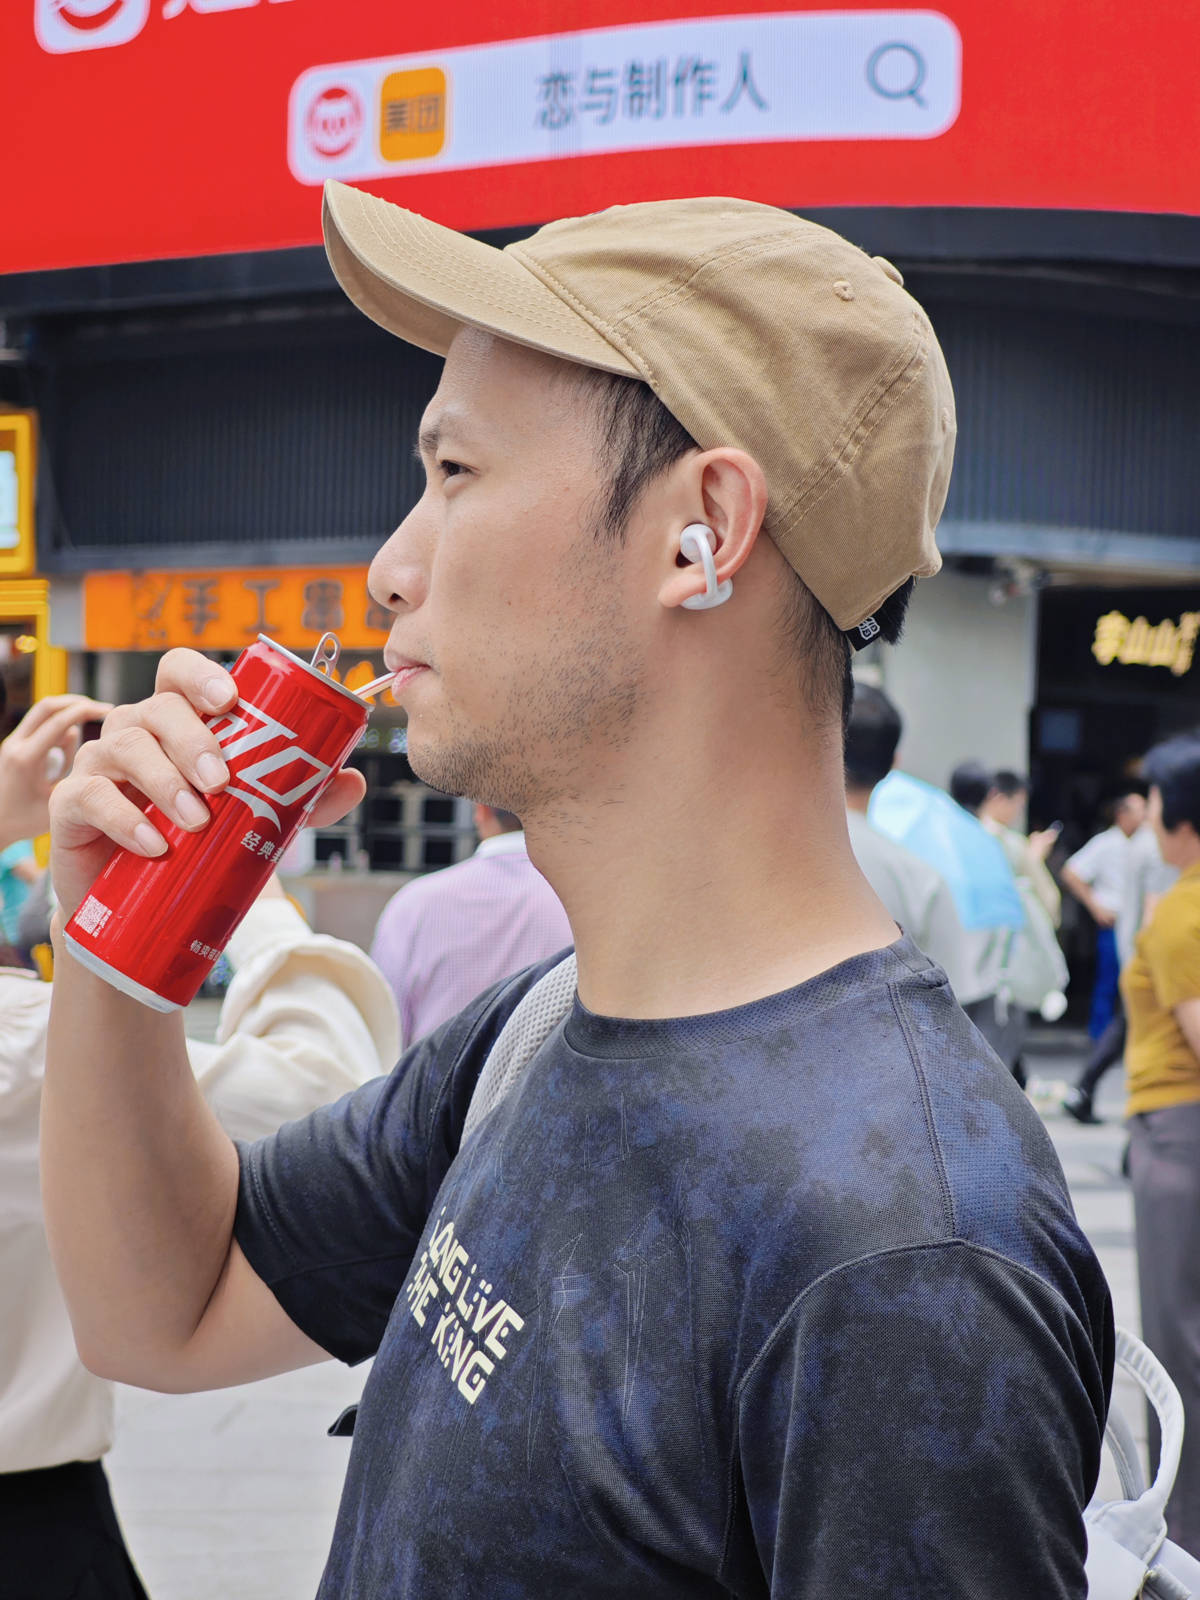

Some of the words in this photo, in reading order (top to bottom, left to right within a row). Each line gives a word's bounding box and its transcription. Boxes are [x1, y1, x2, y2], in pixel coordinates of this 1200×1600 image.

[386, 93, 441, 134] 美团
[537, 51, 768, 129] 恋与制作人
[407, 1252, 439, 1328] THE
[431, 1302, 495, 1405] KING
[429, 1206, 469, 1296] LONG
[456, 1263, 525, 1361] LIVE
